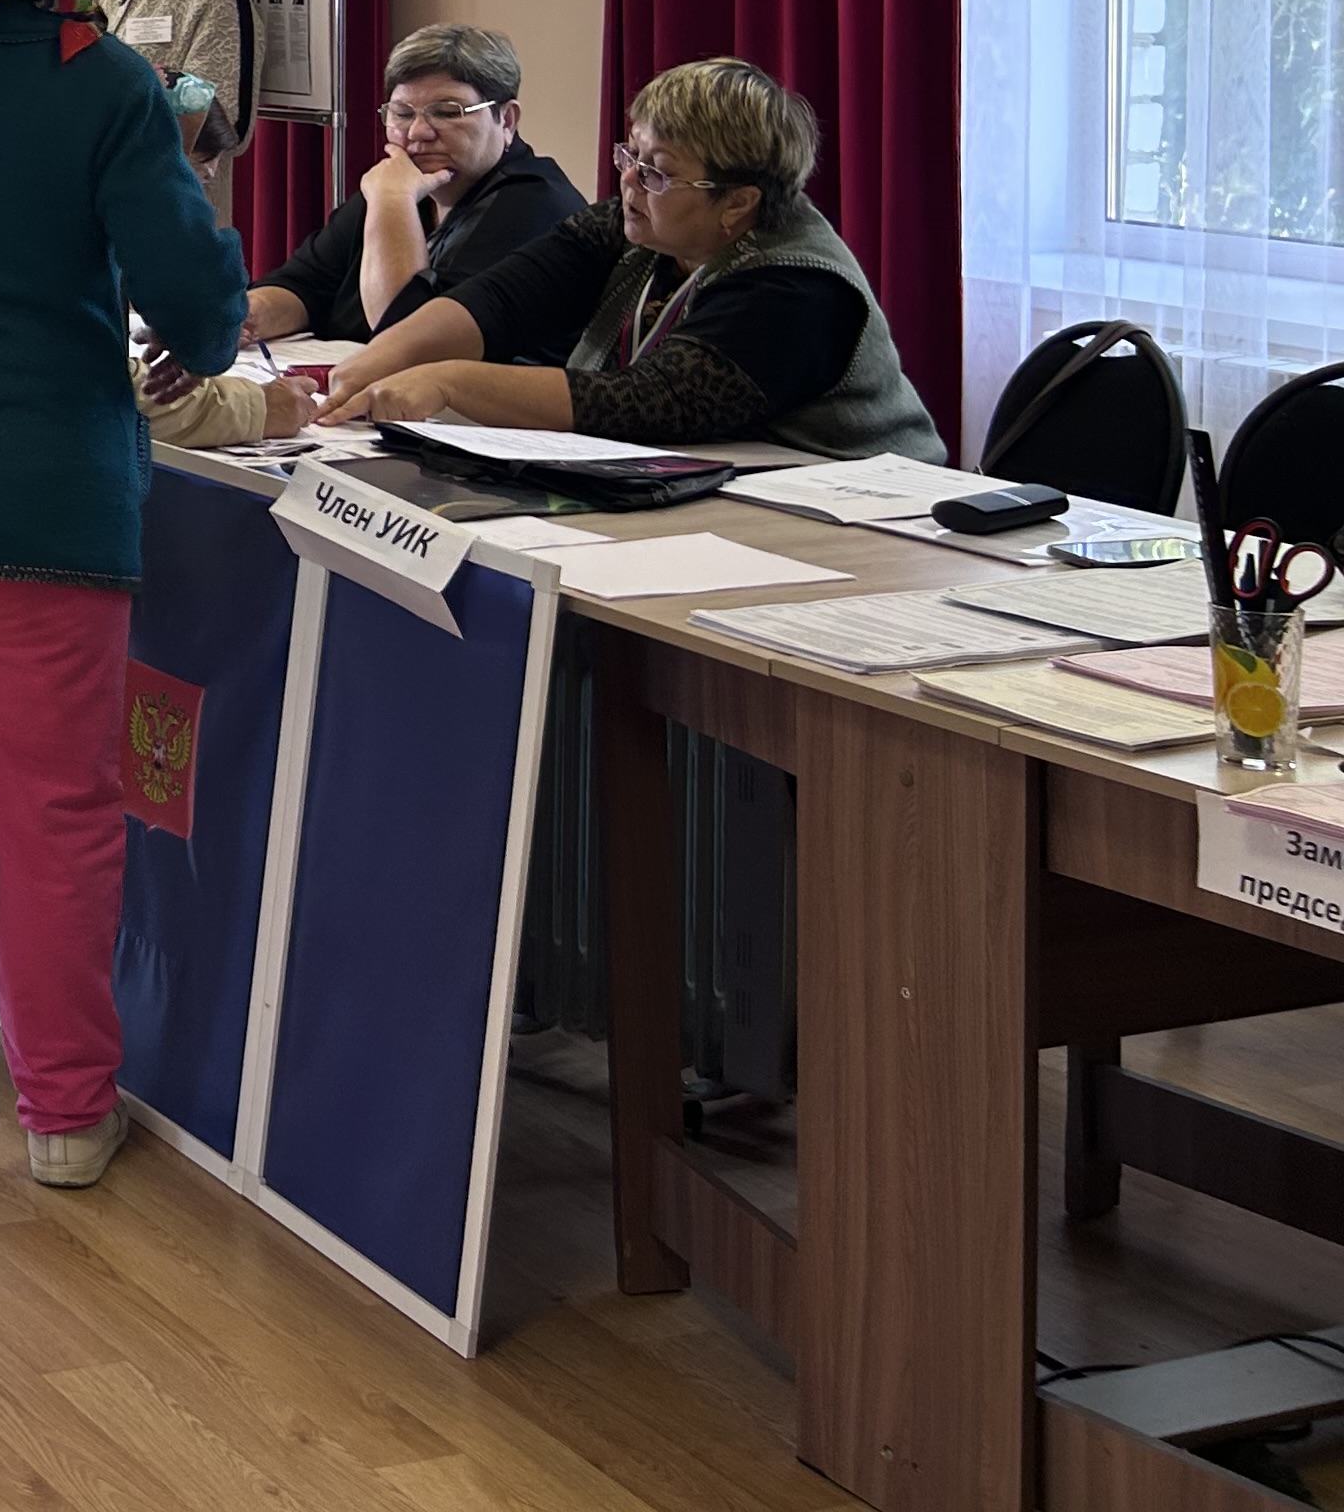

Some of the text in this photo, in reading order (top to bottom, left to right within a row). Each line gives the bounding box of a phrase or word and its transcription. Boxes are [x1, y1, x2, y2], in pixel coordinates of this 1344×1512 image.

[315, 481, 440, 559] Член УИК
[1285, 830, 1343, 870] Зам
[1239, 874, 1344, 931] предсе
